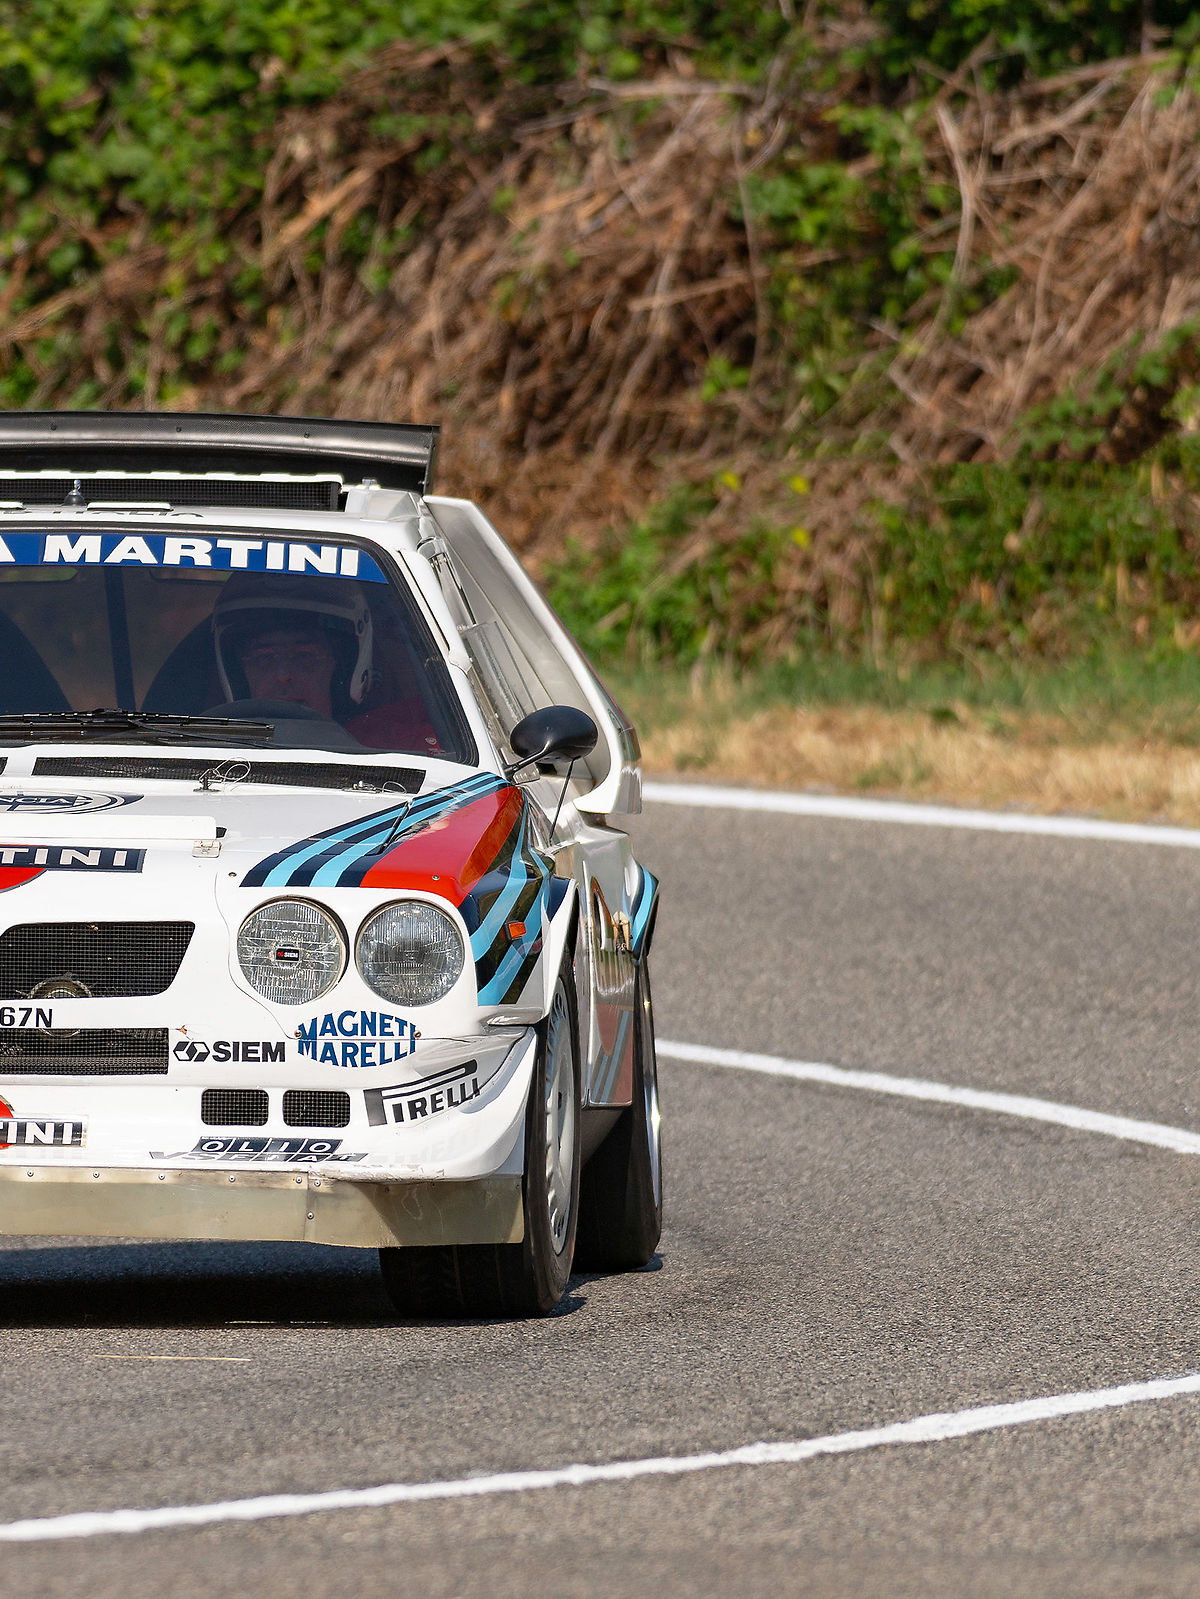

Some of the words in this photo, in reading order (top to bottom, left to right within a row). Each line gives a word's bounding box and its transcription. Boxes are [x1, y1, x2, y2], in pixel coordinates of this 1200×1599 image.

[42, 535, 360, 577] MARTINI
[297, 1010, 417, 1040] MAGNETI
[212, 1041, 286, 1063] SIEM
[297, 1041, 416, 1068] MARELLI
[363, 1059, 481, 1127] PIRELLI
[201, 1138, 332, 1153] OLIO
